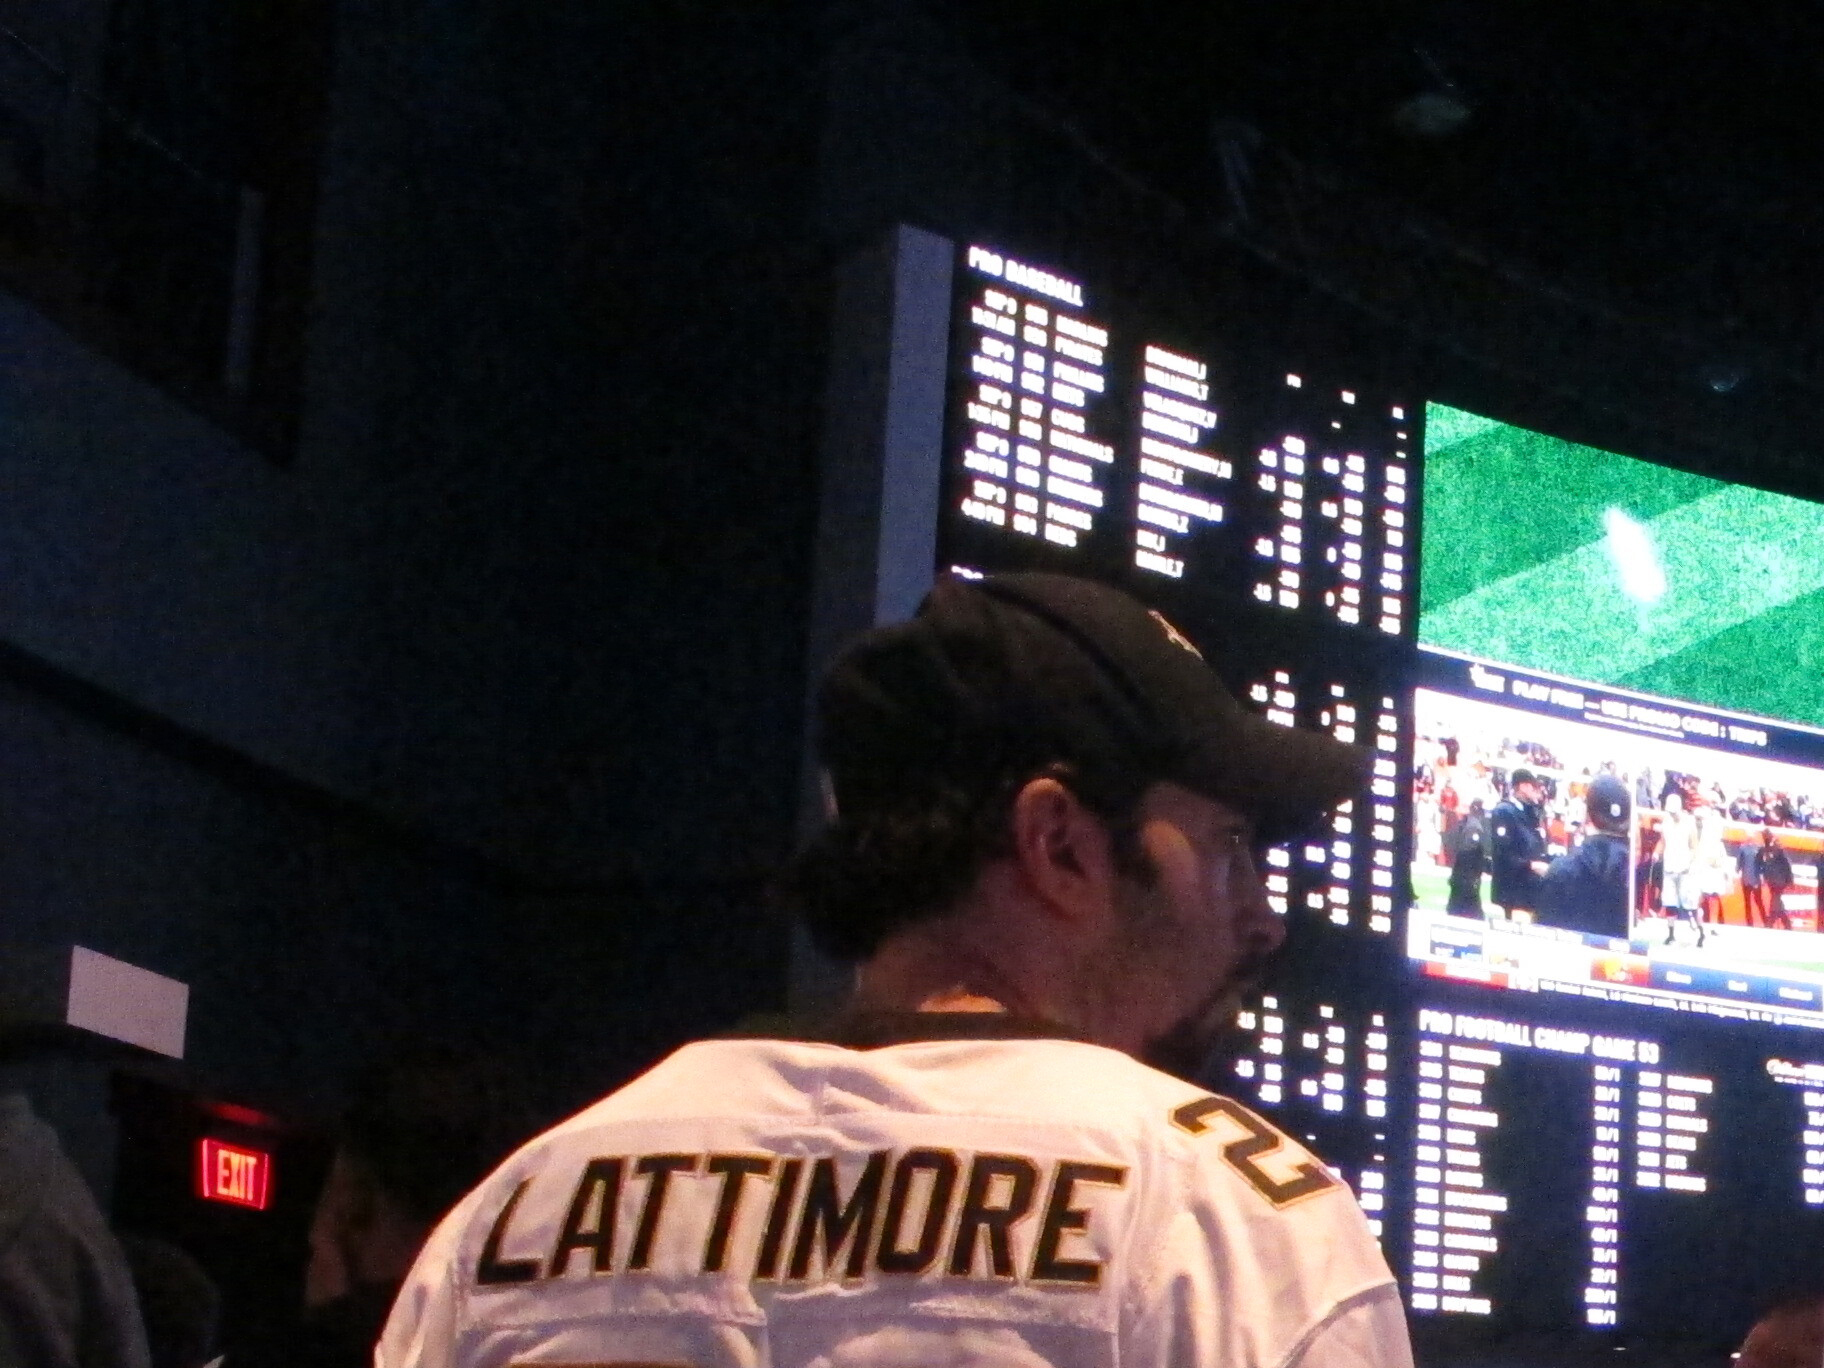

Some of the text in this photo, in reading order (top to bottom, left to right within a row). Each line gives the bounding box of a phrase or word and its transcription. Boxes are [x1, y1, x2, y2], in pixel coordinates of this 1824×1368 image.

[969, 246, 1083, 307] PRO BASEBALL
[1419, 1010, 1660, 1064] PRO FOOTBALL CHAMP GAME 53
[217, 1149, 257, 1201] EXIT
[477, 1148, 1131, 1288] LATTIMORE
